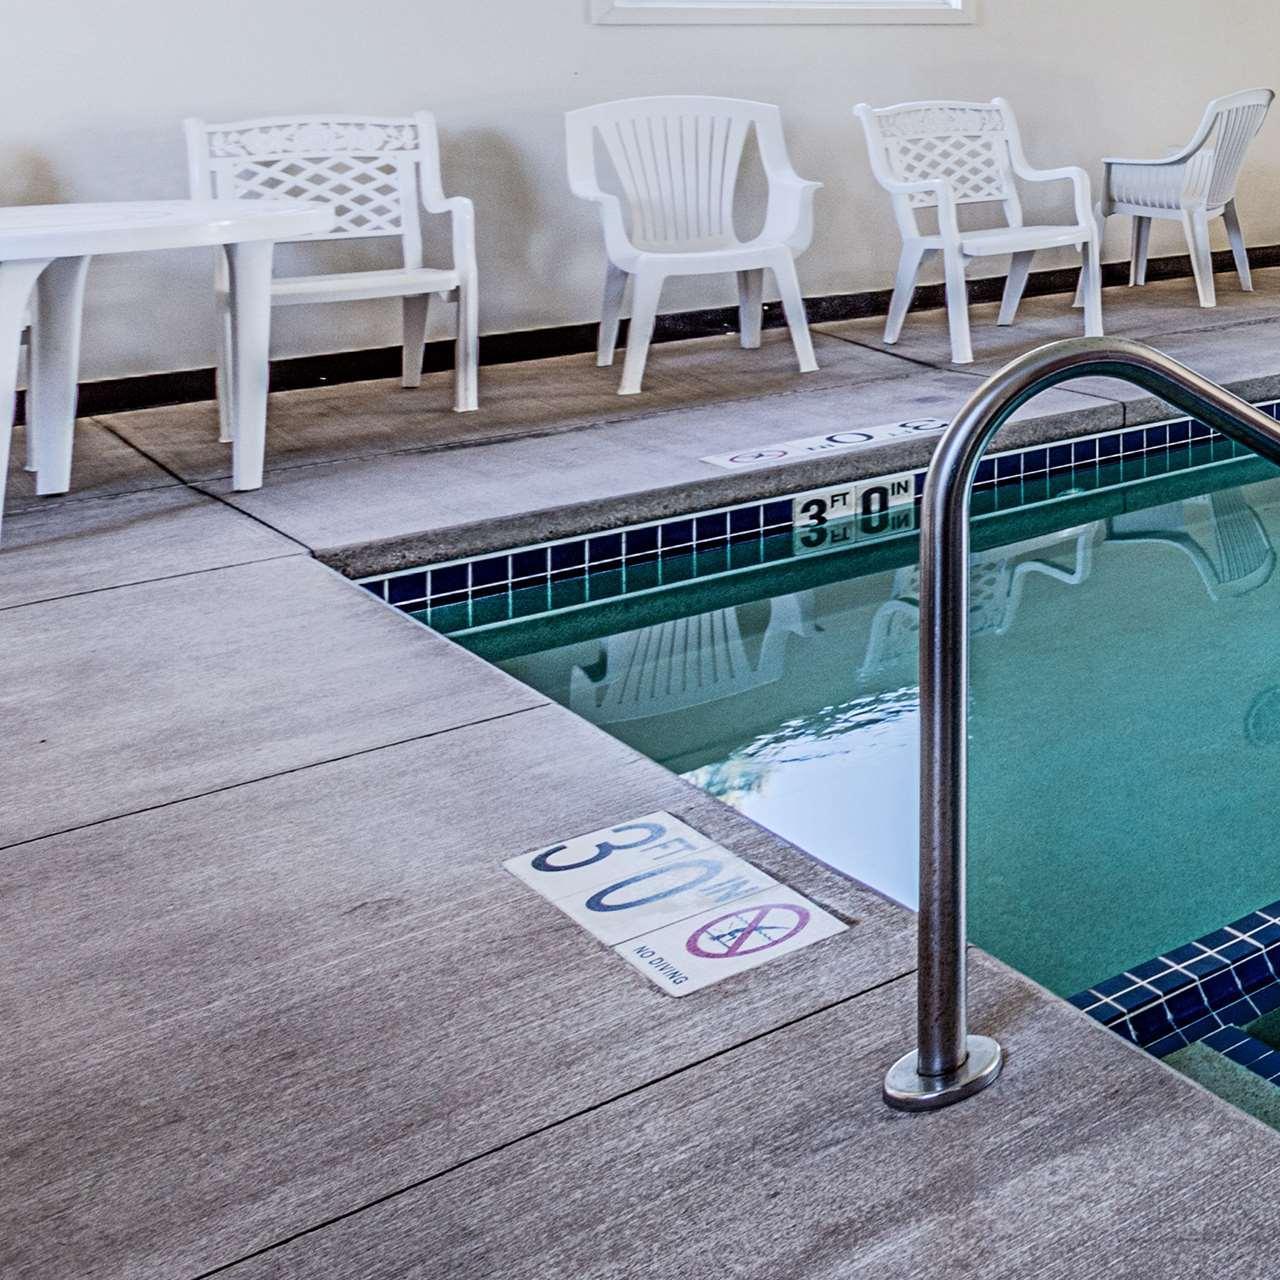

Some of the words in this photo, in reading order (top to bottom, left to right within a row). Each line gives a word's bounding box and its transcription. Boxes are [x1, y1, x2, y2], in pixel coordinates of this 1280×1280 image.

[800, 498, 828, 527] 3
[830, 491, 851, 509] FT
[891, 479, 910, 497] IN
[530, 821, 667, 873] 3
[640, 837, 697, 860] FT
[700, 876, 760, 903] IN
[633, 945, 656, 959] NO
[648, 957, 689, 985] DIVING
